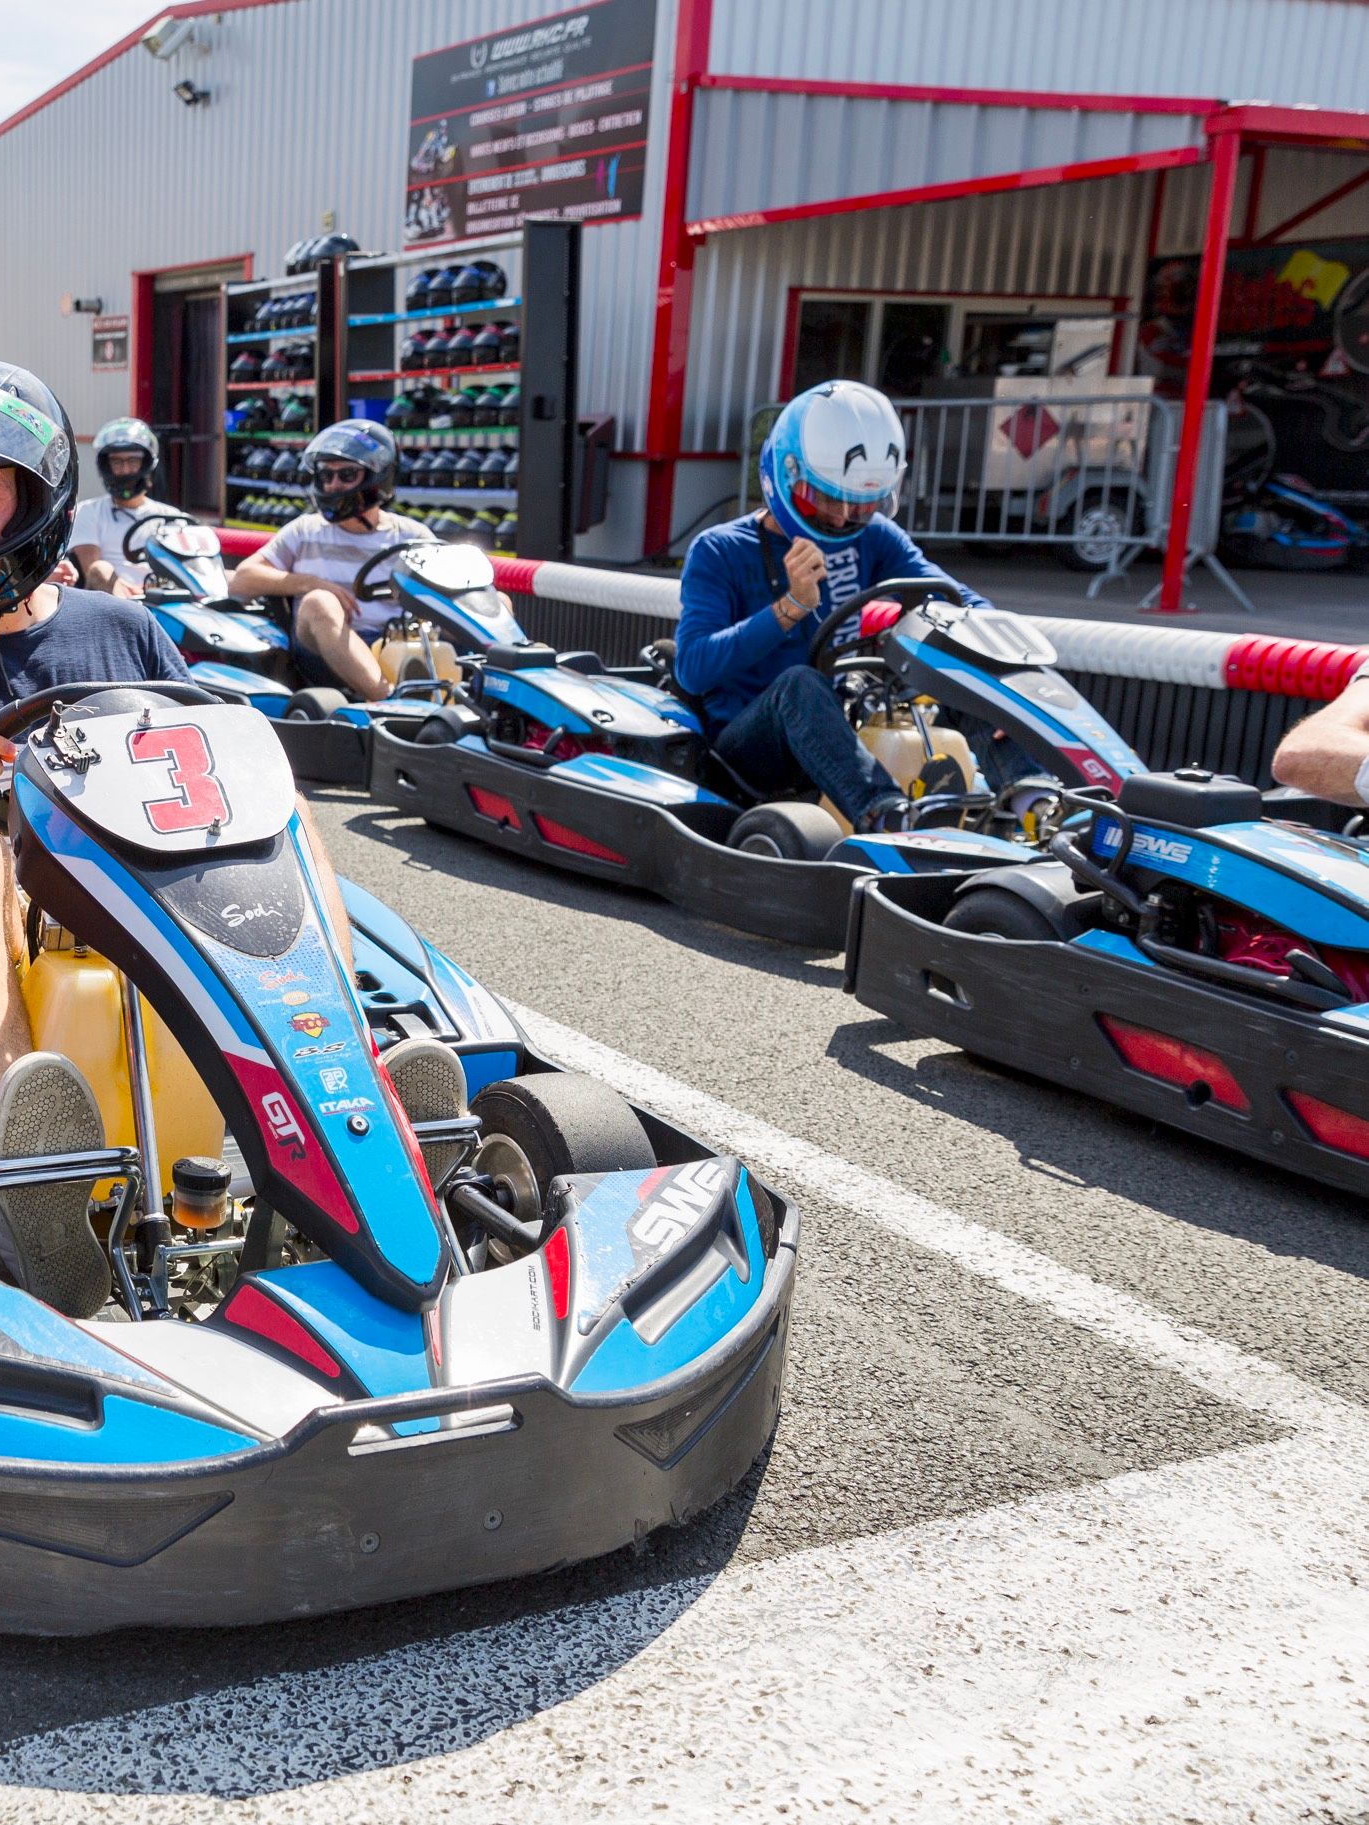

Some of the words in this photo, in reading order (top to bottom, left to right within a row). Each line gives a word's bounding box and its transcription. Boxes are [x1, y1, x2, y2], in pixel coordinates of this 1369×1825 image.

[126, 723, 233, 835] 3
[221, 903, 283, 928] Sodi
[632, 1160, 727, 1254] SWS
